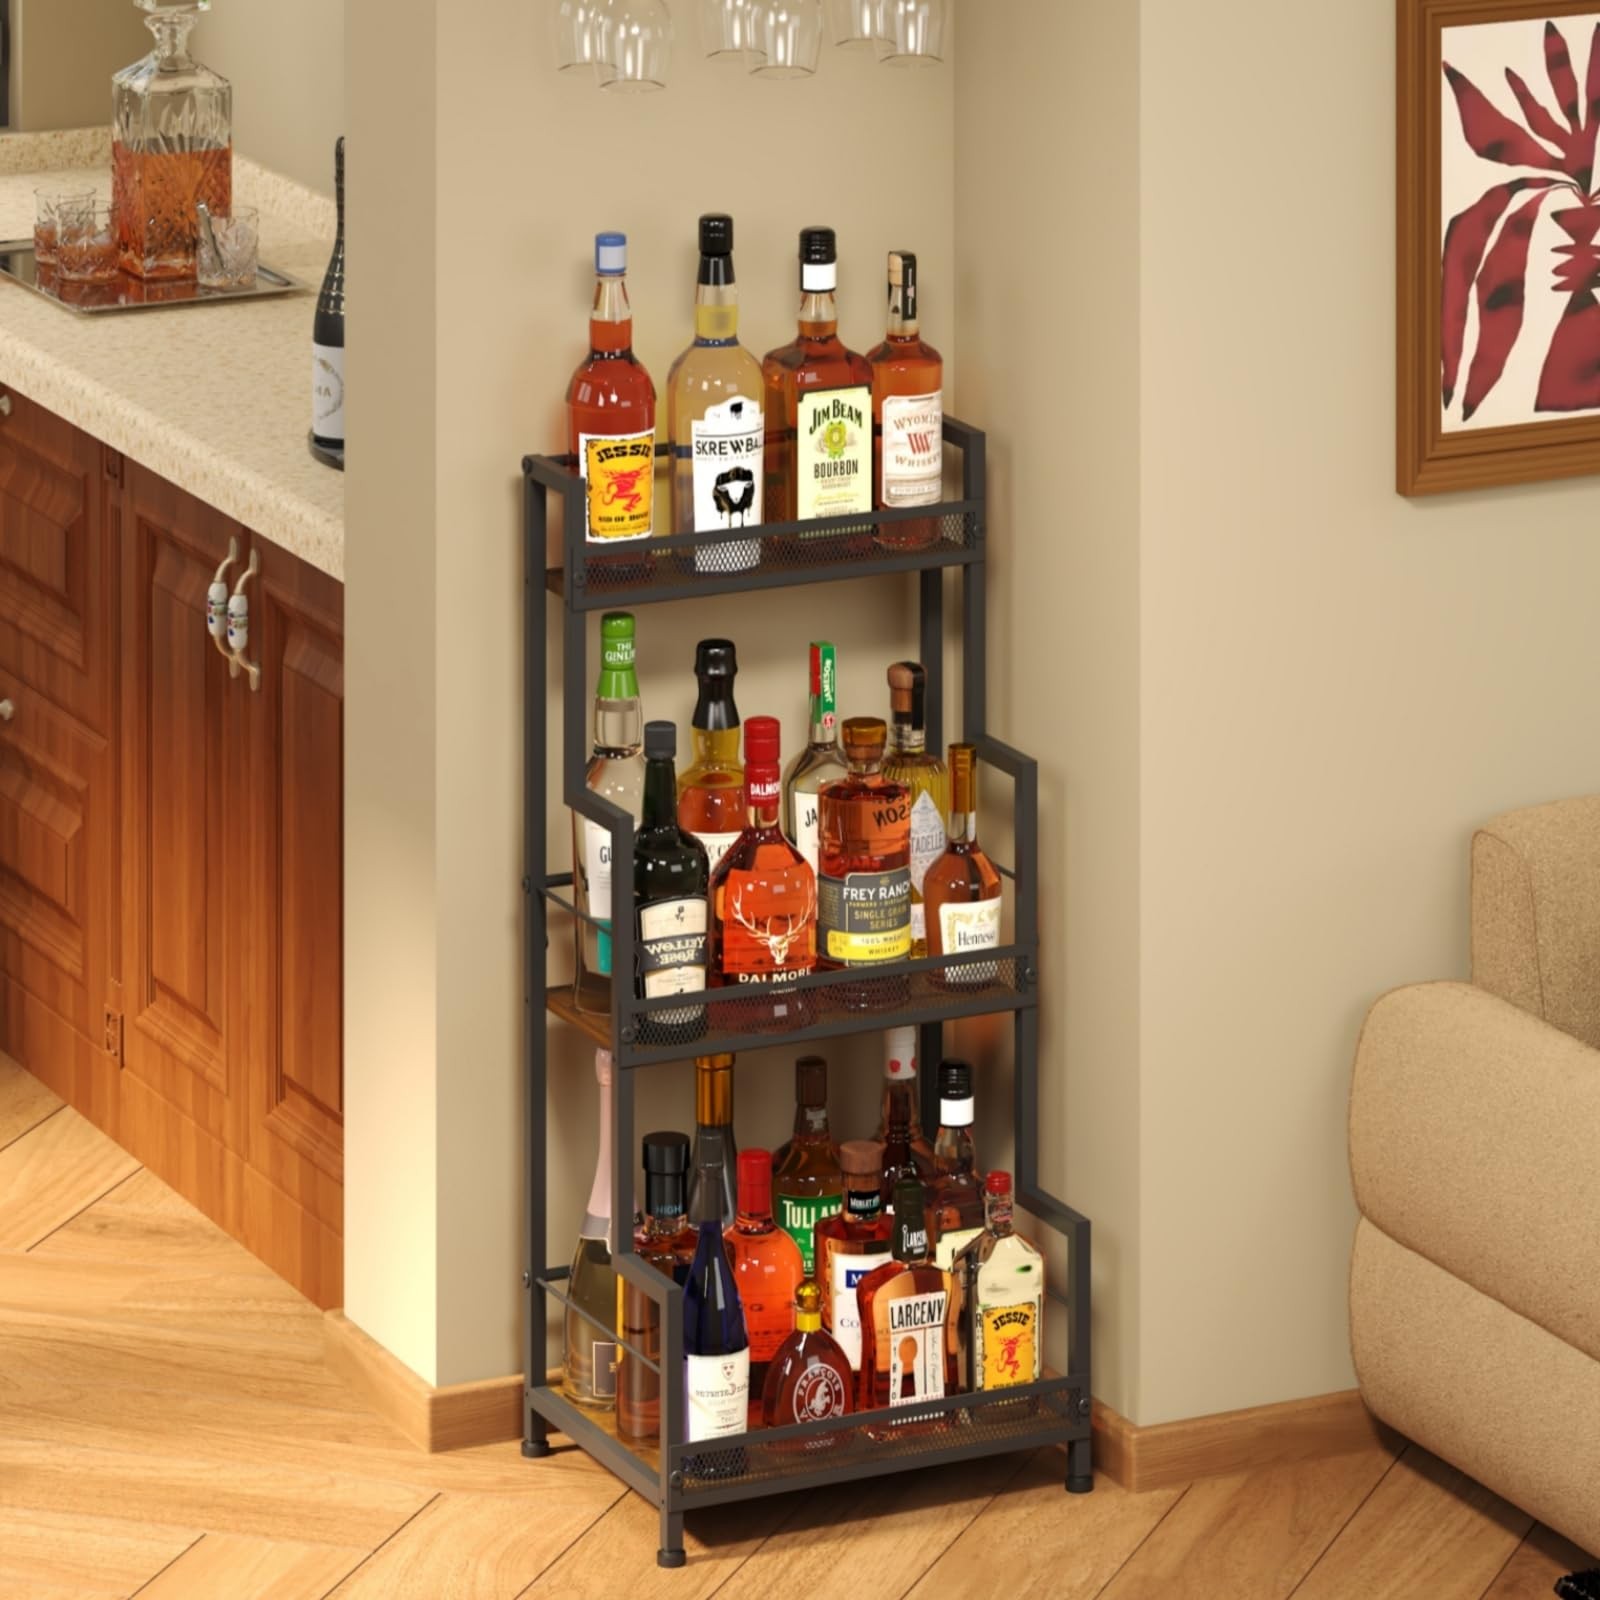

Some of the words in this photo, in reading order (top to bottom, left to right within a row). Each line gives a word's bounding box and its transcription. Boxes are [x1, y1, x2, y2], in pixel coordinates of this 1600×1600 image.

[809, 406, 830, 435] JIM
[832, 399, 862, 428] BEAM
[814, 459, 858, 479] BOURBON
[843, 887, 876, 901] FREY
[854, 908, 885, 920] SINGLE
[890, 1298, 944, 1329] LARCENY
[992, 1311, 1030, 1331] JESSIE
